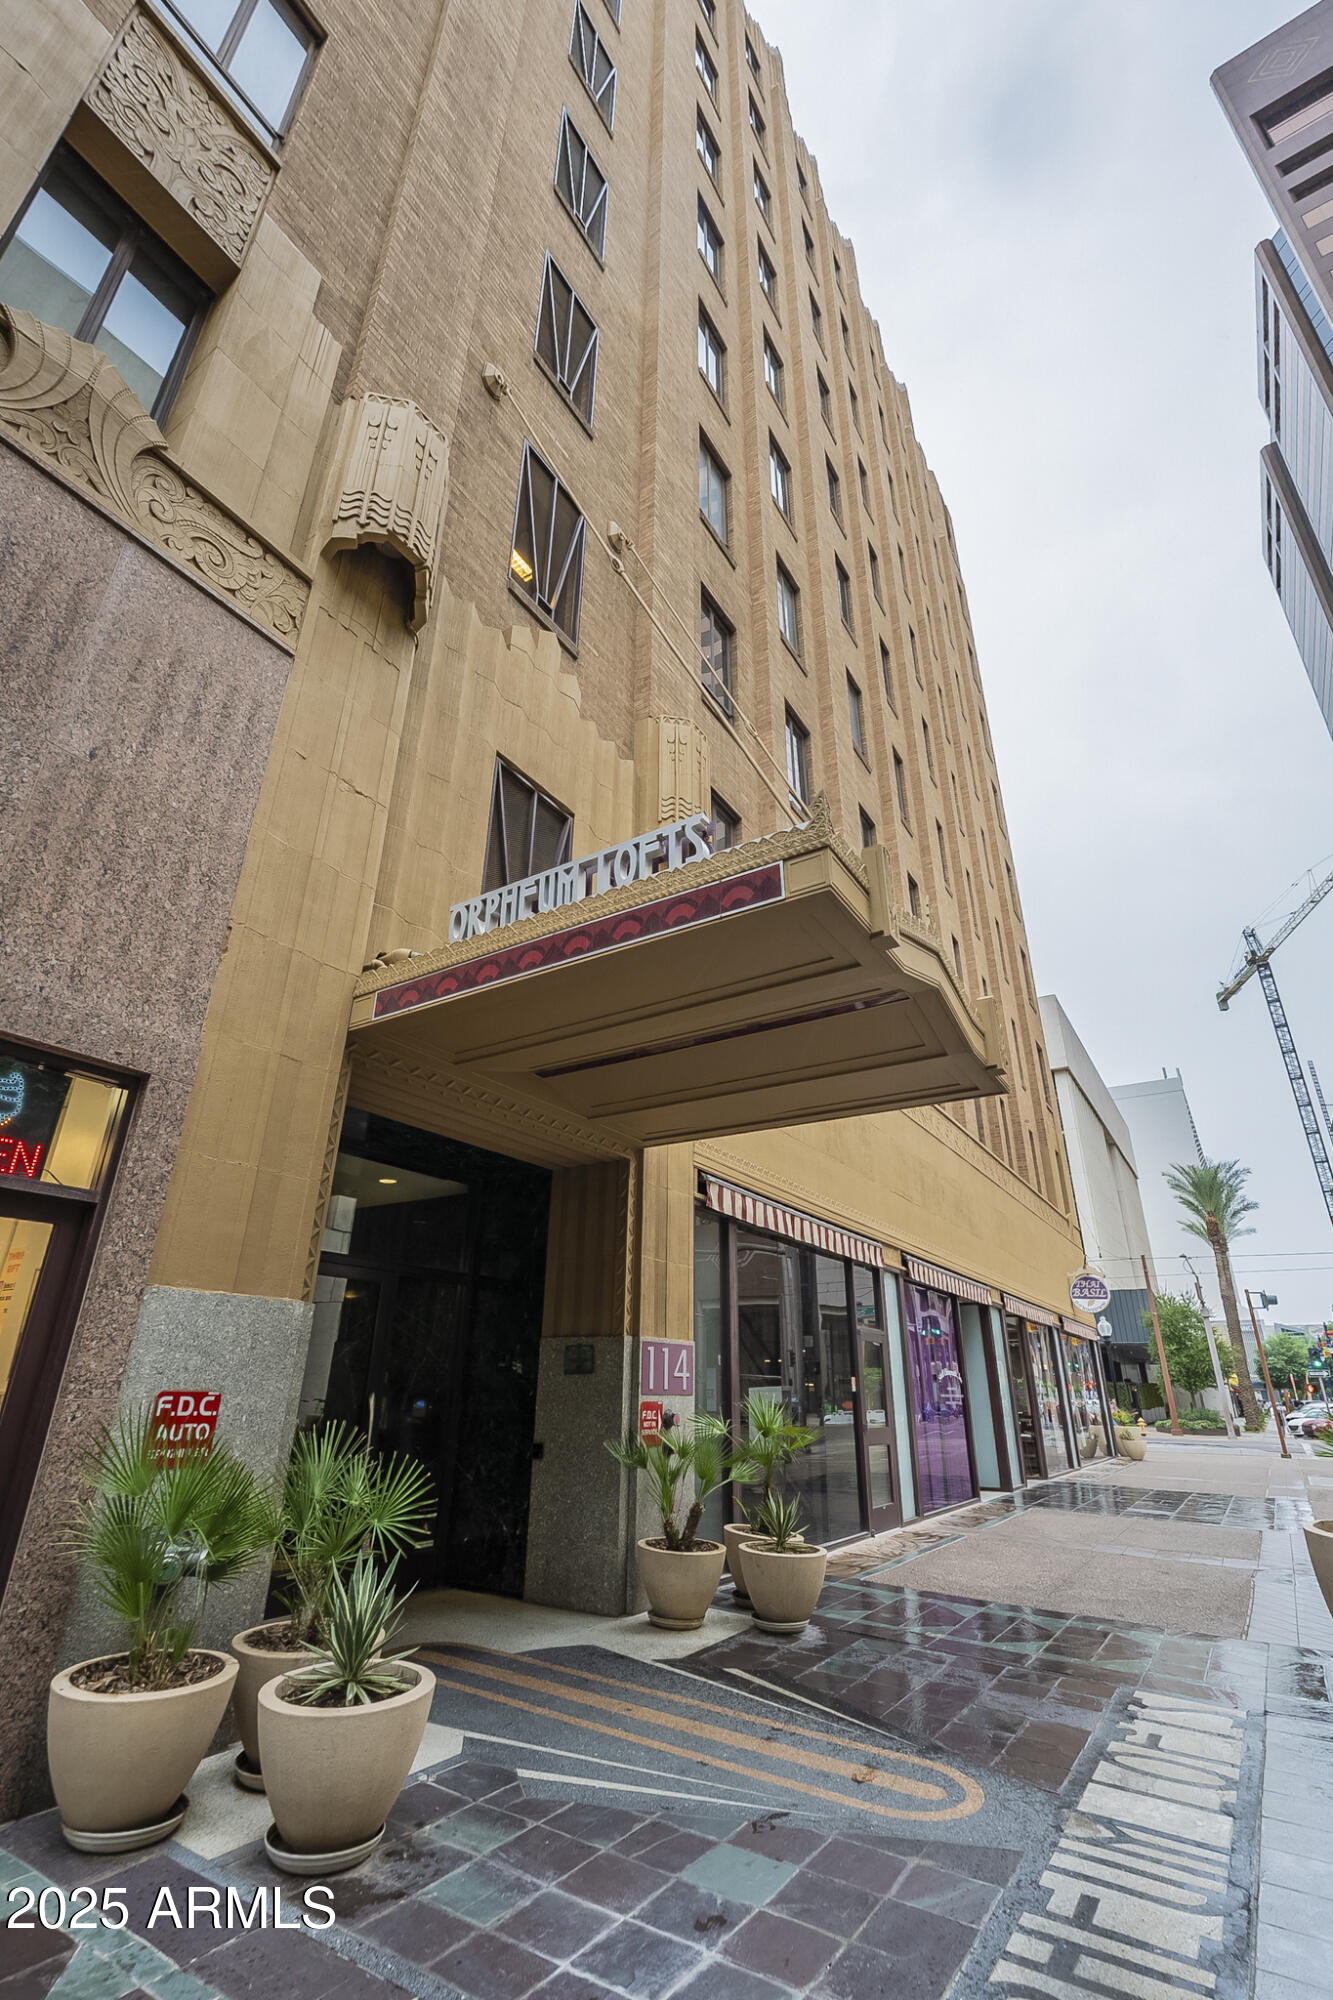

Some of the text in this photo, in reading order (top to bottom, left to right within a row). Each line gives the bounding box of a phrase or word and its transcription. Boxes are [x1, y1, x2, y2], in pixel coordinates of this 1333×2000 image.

[449, 813, 713, 942] ORPHEUM LOFTS
[1072, 1288, 1107, 1297] BASIL
[1075, 1280, 1101, 1288] THAI
[647, 1346, 690, 1390] 114
[156, 1395, 217, 1416] F.D.C.
[156, 1423, 210, 1441] AUTO
